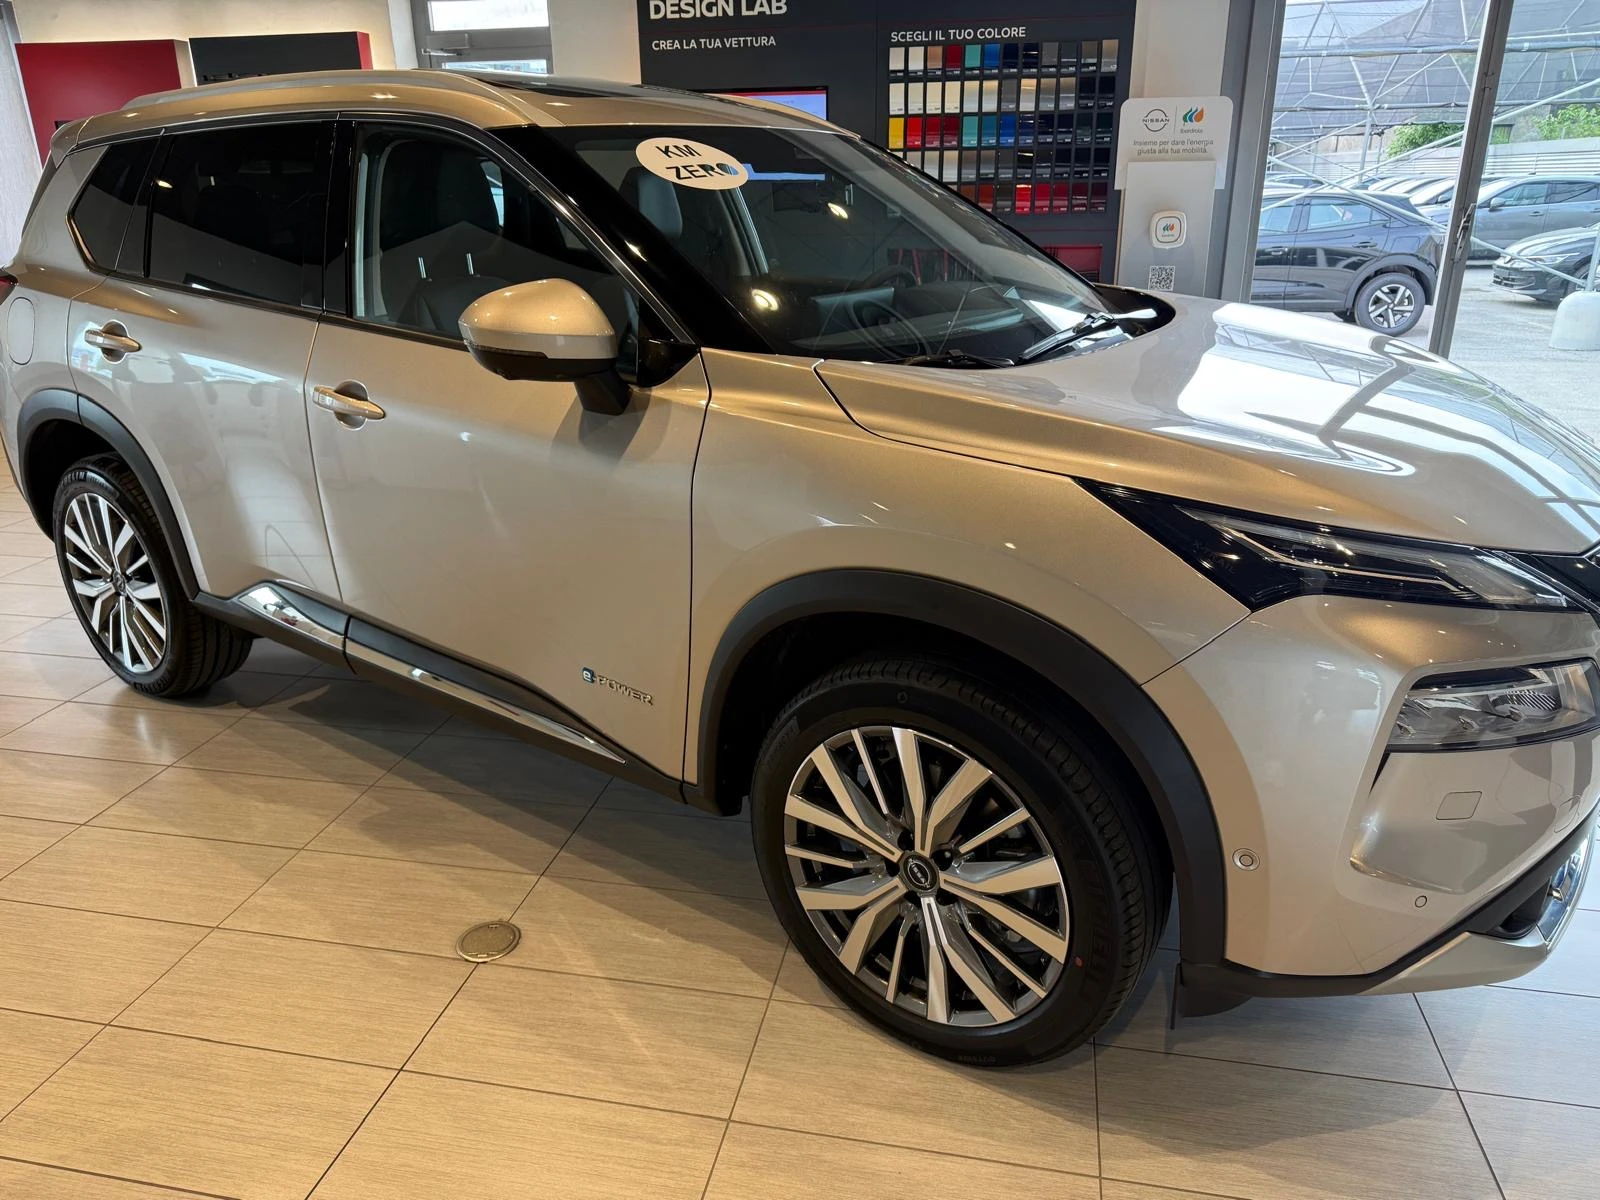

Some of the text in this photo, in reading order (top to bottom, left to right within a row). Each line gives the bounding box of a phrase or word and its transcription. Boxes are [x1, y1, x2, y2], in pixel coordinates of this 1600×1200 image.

[649, 0, 787, 19] DESIGN LAB
[890, 26, 1027, 42] SCEGLI IL TUO COLORE
[651, 36, 776, 51] CREA LA TUA VETTURA
[1186, 138, 1214, 147] l'energia
[655, 144, 702, 158] KM
[1137, 147, 1157, 156] giusta
[665, 163, 739, 180] ZERO
